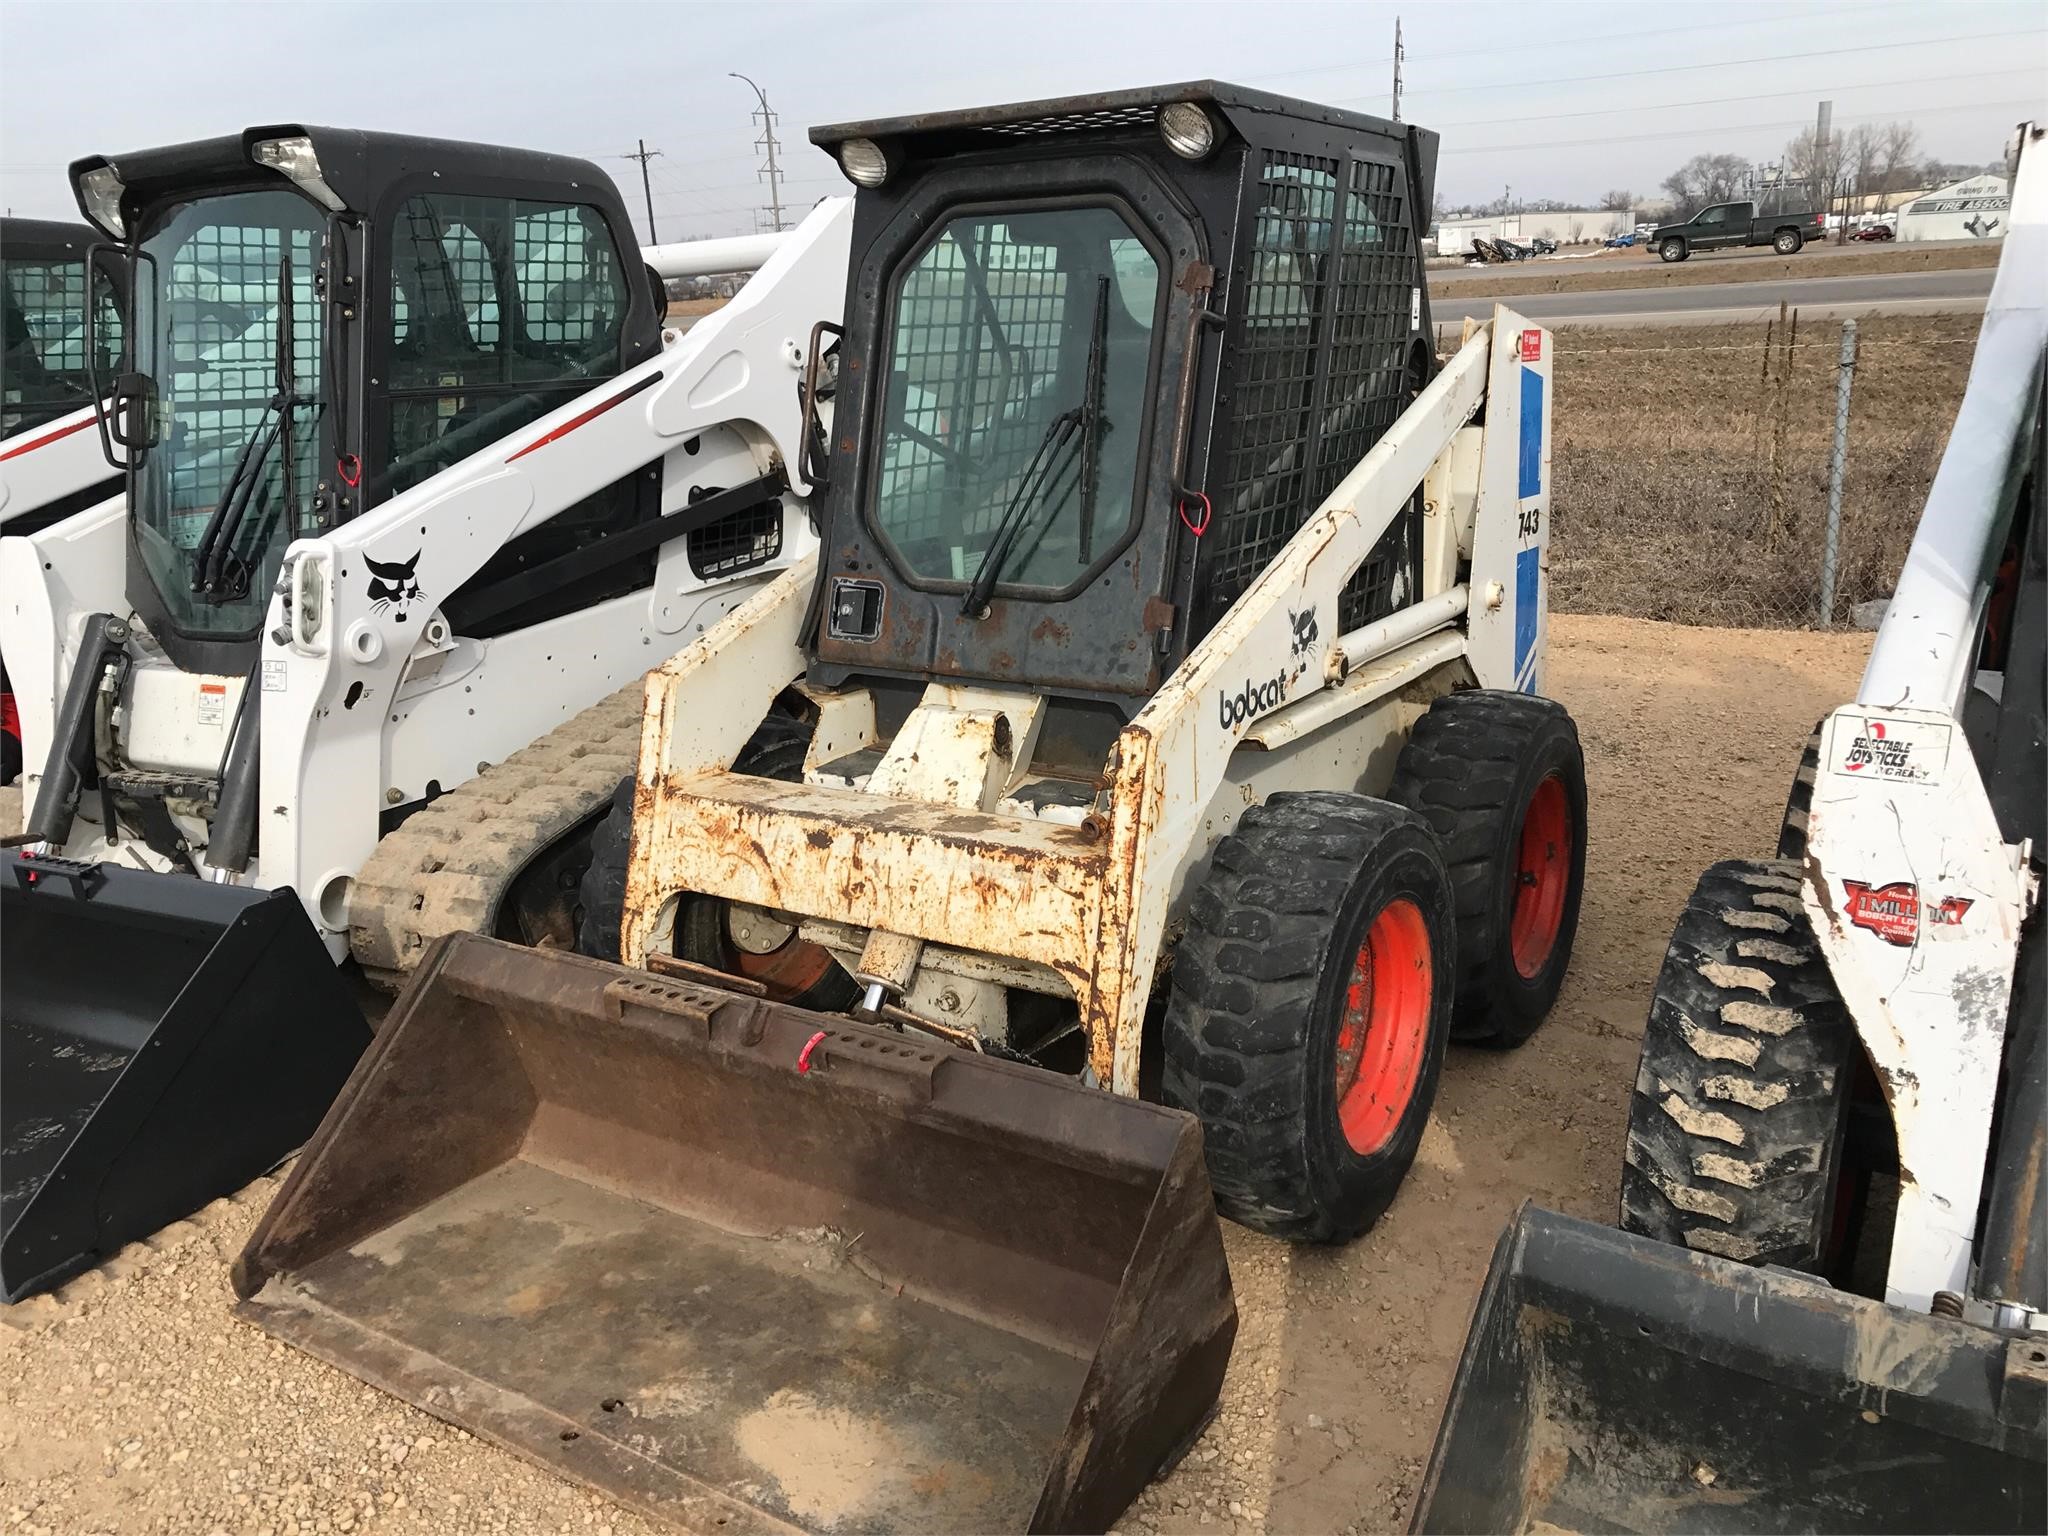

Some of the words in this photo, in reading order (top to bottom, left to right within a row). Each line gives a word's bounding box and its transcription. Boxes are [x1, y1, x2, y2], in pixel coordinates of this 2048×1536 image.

[1935, 201, 1963, 211] TIRE
[1518, 508, 1540, 538] 743
[1219, 667, 1287, 730] bobcat
[1887, 890, 1913, 901] Home
[1857, 909, 1900, 924] BOBCAT
